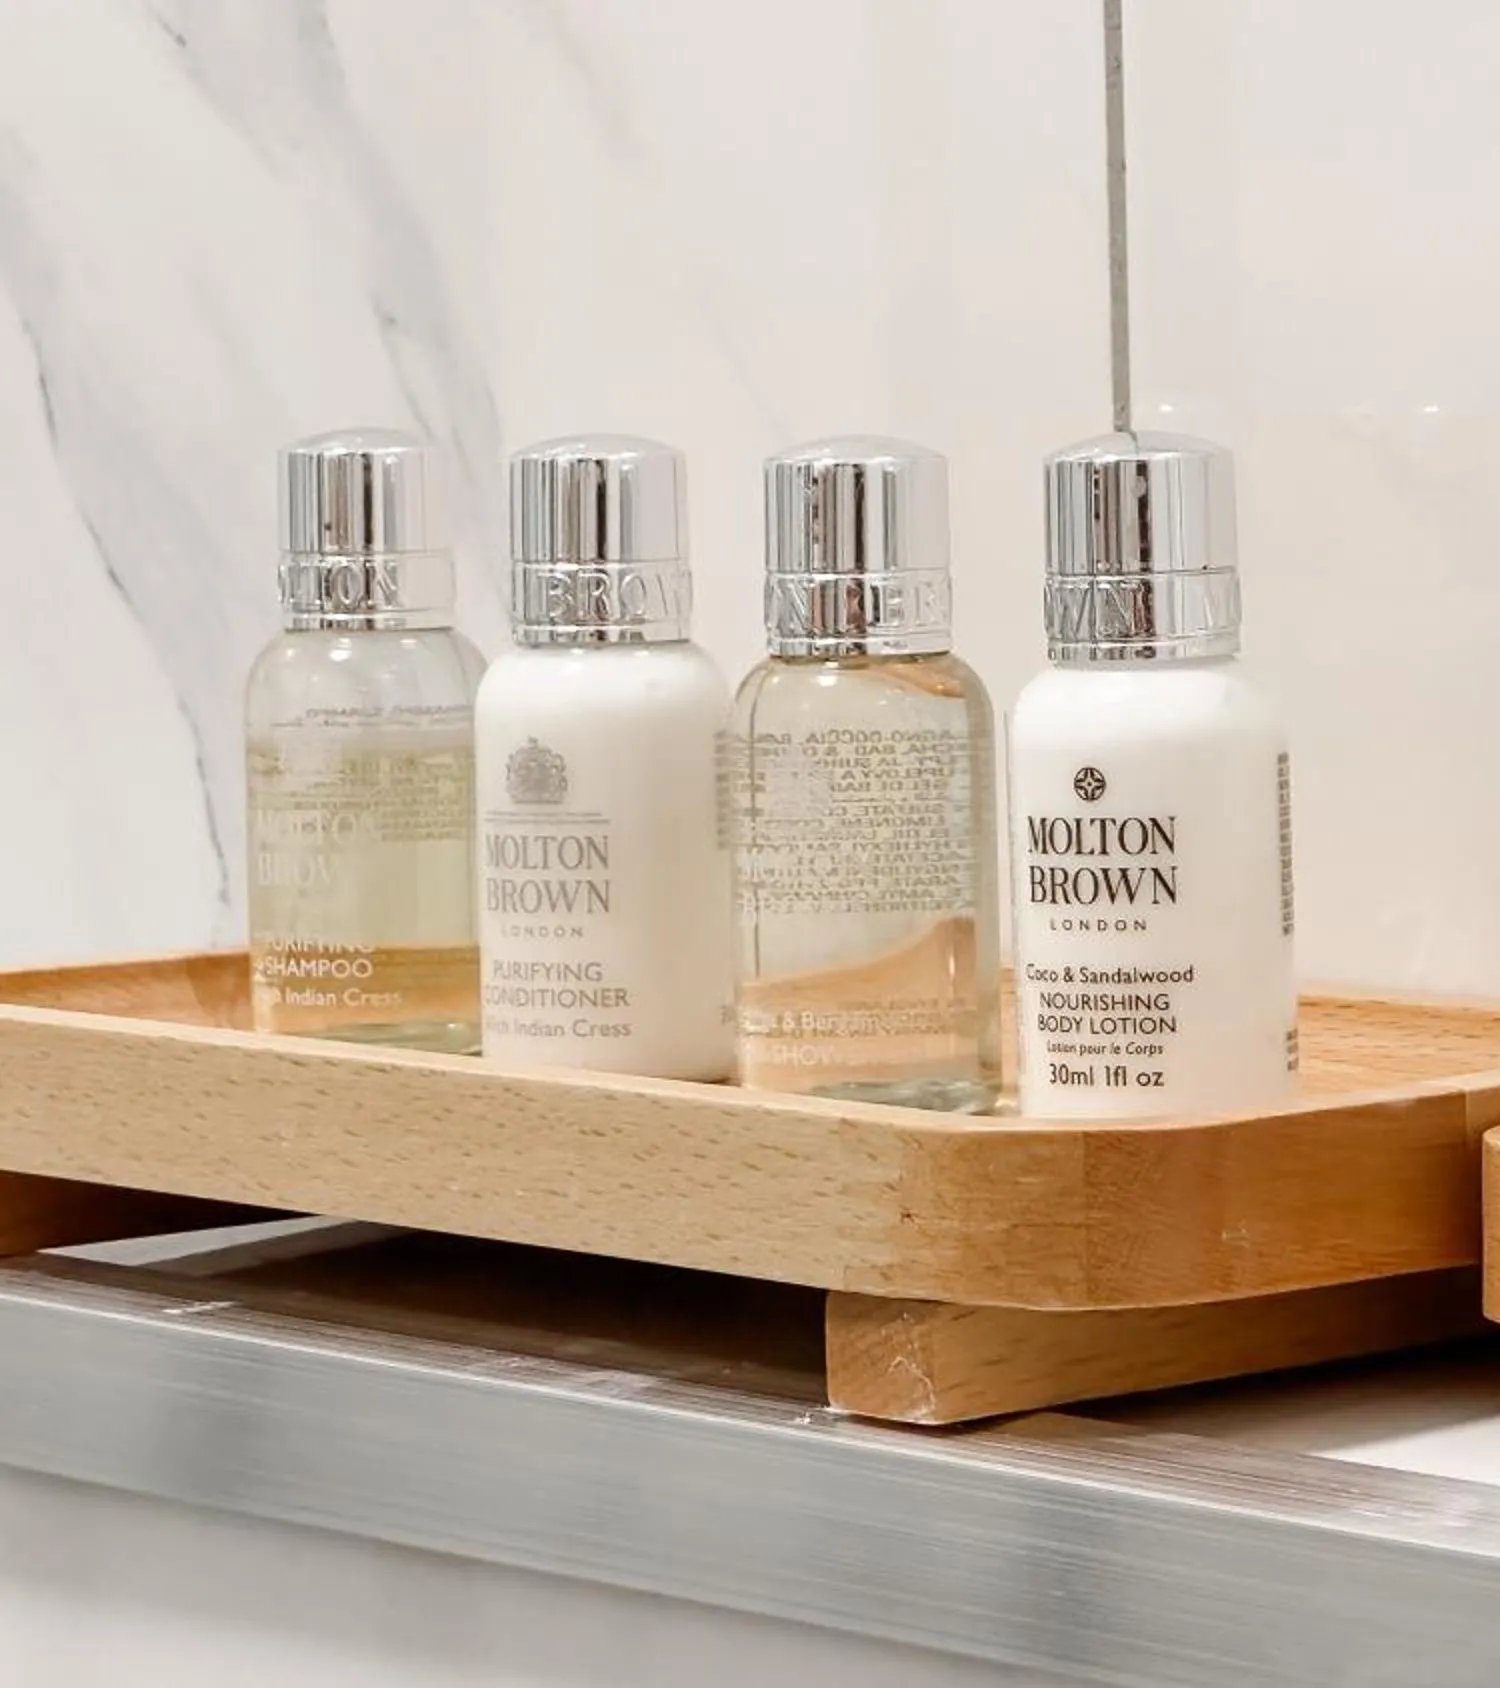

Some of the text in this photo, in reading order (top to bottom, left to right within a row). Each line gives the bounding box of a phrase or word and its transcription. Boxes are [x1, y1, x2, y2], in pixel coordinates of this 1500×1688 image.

[1026, 815, 1177, 856] MOLTON
[485, 833, 609, 870] MOLTON
[486, 877, 611, 914] BROWN
[1028, 865, 1179, 905] BROWN
[501, 923, 584, 939] LONDON
[1049, 918, 1148, 932] LONDON
[264, 955, 374, 979] SHAMPOO
[493, 958, 605, 983] PURIFYING
[1025, 962, 1195, 985] Coco & Sandalwood
[285, 986, 338, 1007] Indian
[485, 984, 631, 1009] CONDITIONER
[1038, 992, 1171, 1012] NOURISHING
[514, 1016, 565, 1037] Indian
[572, 1018, 634, 1038] Cress
[1038, 1014, 1177, 1035] BODY LOTION
[1079, 1043, 1107, 1057] pour
[1125, 1042, 1164, 1057] Corps
[1049, 1063, 1094, 1086] 30ml
[1136, 1072, 1165, 1087] oz
